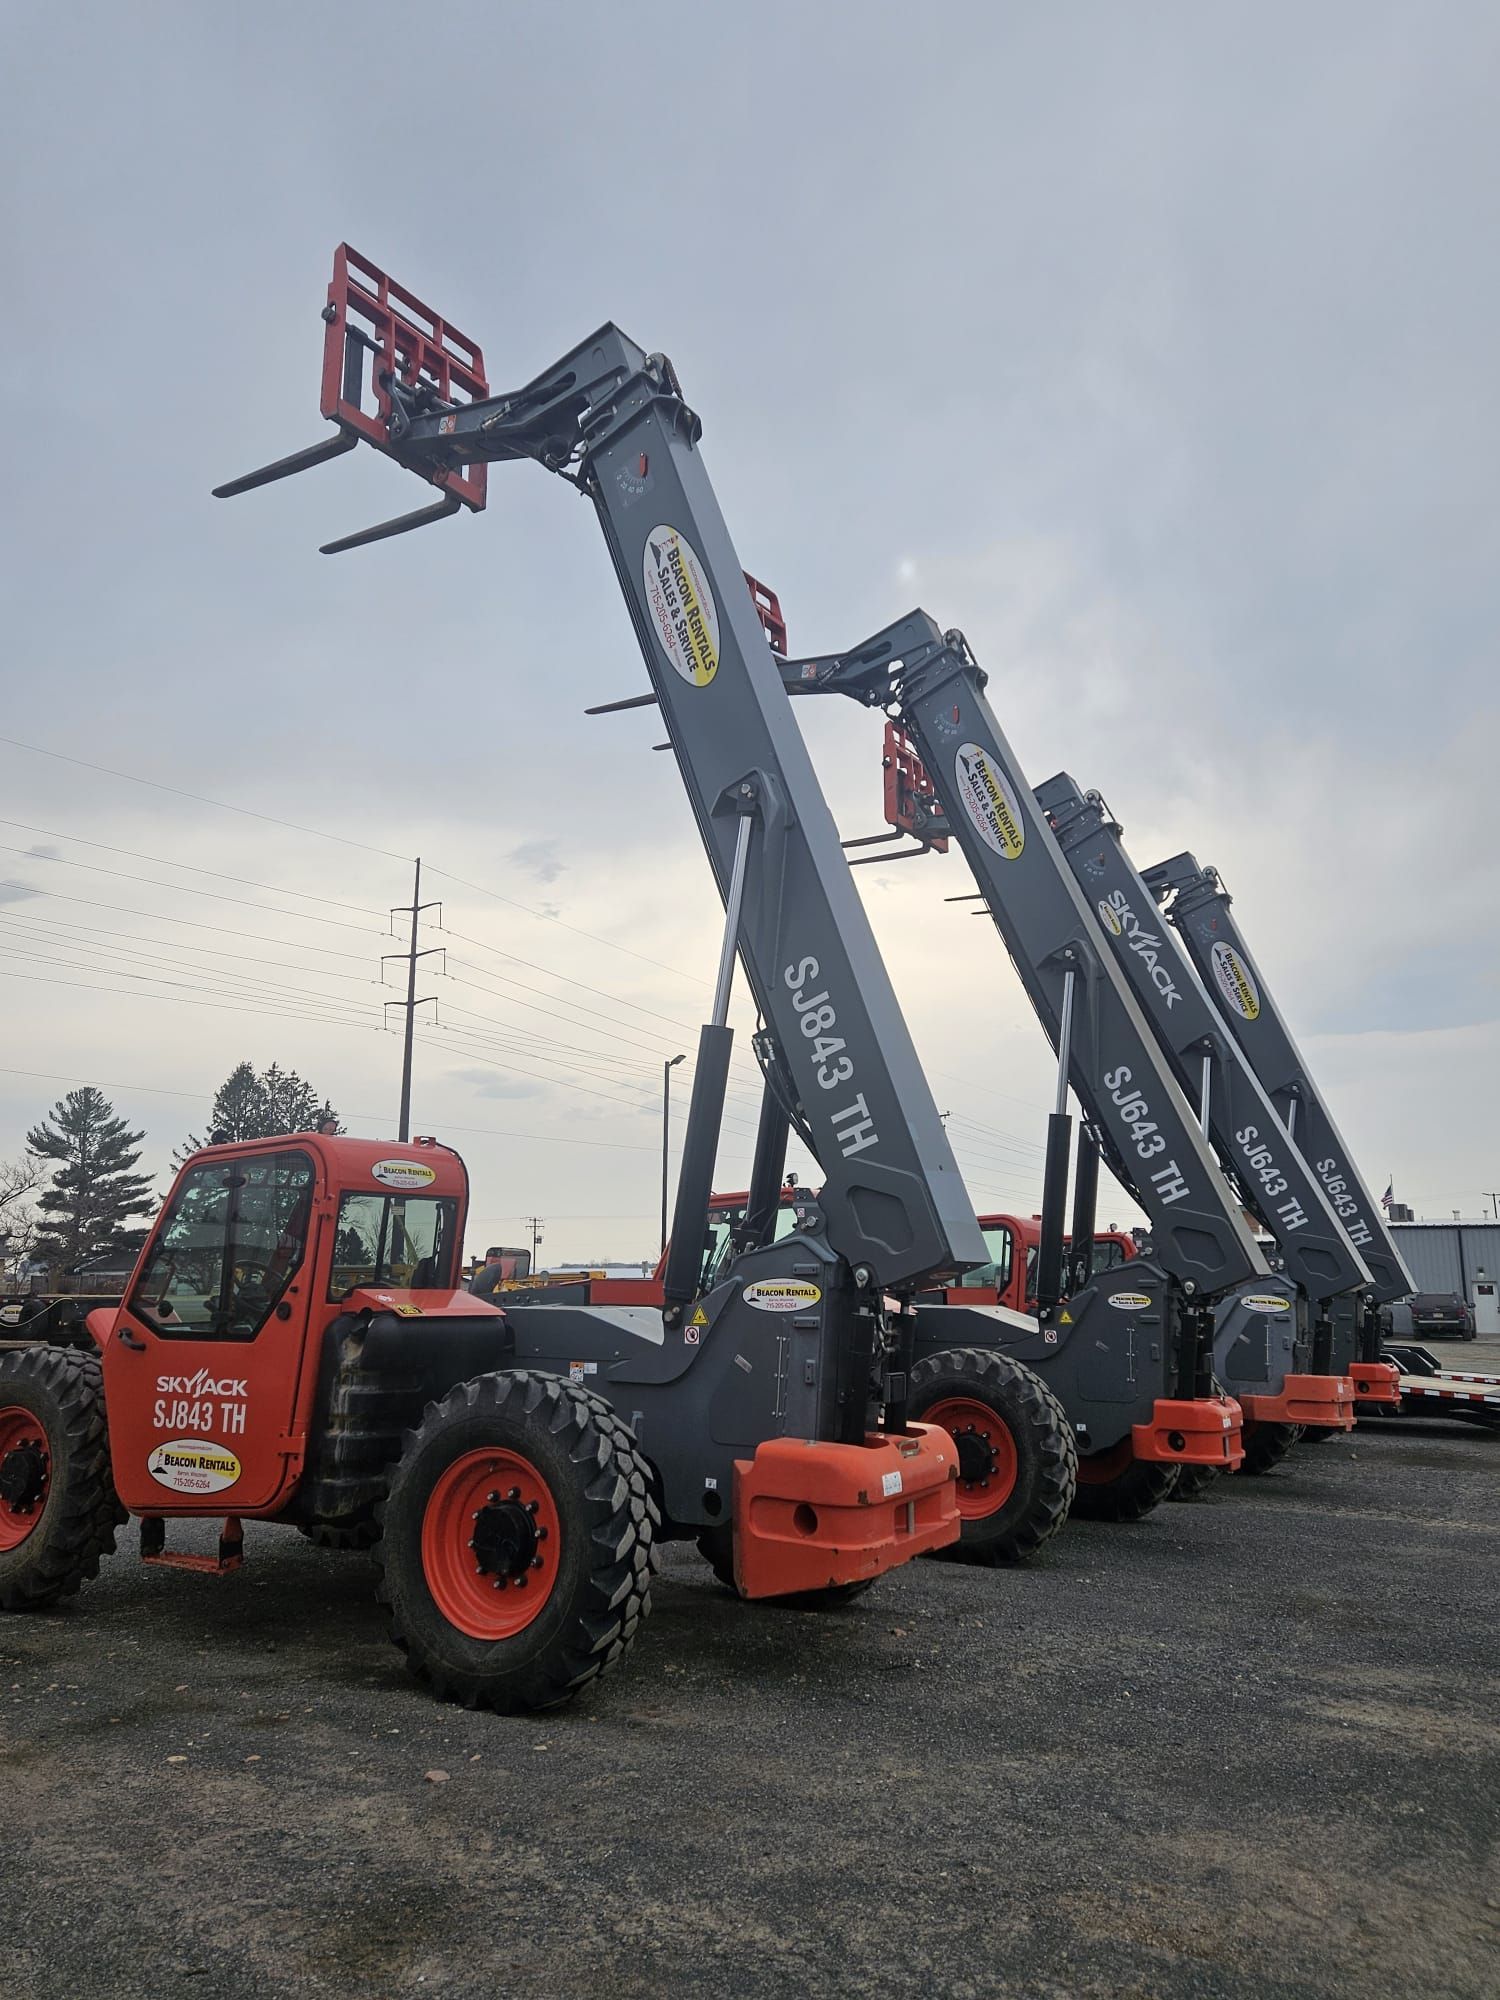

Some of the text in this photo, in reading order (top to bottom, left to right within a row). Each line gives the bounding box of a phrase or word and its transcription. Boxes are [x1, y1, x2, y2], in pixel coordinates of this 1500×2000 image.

[658, 566, 677, 607] SALES
[667, 546, 715, 671] BEACON RENTALS
[671, 607, 680, 621] &
[651, 584, 676, 649] 715-205-6264
[675, 619, 699, 672] SERVICE
[963, 787, 988, 832] 715-205-6264
[968, 773, 986, 802] SALES
[981, 802, 990, 811] &
[986, 810, 1009, 849] SERVICE
[974, 759, 999, 802] BEACON
[994, 801, 1022, 849] RENTALS
[1108, 889, 1183, 1010] SKYJACK
[1220, 961, 1233, 981] SALES
[1233, 987, 1248, 1012] SERVICE
[1225, 953, 1242, 981] BEACON
[1239, 982, 1258, 1013] RENTALS
[784, 956, 879, 1158] SJ843 TH
[1103, 1066, 1190, 1205] SJ643 TH
[1235, 1126, 1309, 1231] SJ643 TH
[1316, 1158, 1373, 1246] SJ643 TH
[756, 1288, 816, 1296] BEACON RENTALS
[156, 1368, 248, 1398] SKYJACK
[153, 1400, 247, 1433] SJ843 TH
[164, 1454, 236, 1471] BEACON RENTALS
[173, 1477, 210, 1488] 715-205-6264
